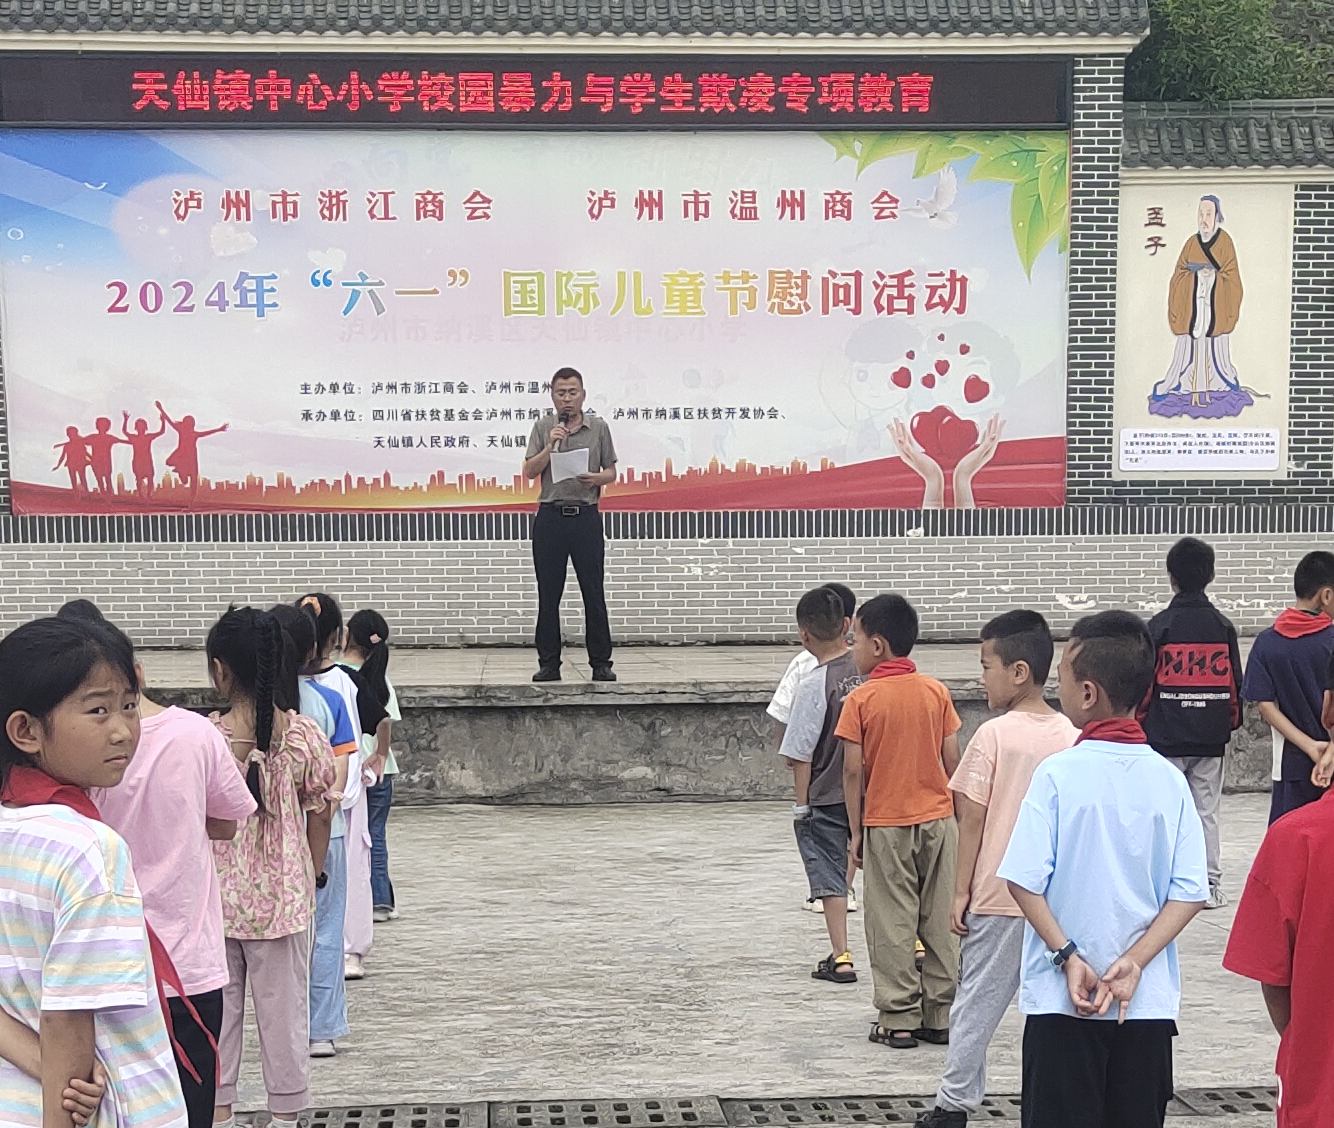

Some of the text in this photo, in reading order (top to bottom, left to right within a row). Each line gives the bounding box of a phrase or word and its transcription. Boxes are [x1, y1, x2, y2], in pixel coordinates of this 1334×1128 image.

[131, 69, 934, 114] 天仙镇中心小学校园暴力与学生欺凌专项教育
[172, 189, 901, 223] 泸州市浙江商会 泸州市温州商会
[1144, 206, 1167, 256] 孟子
